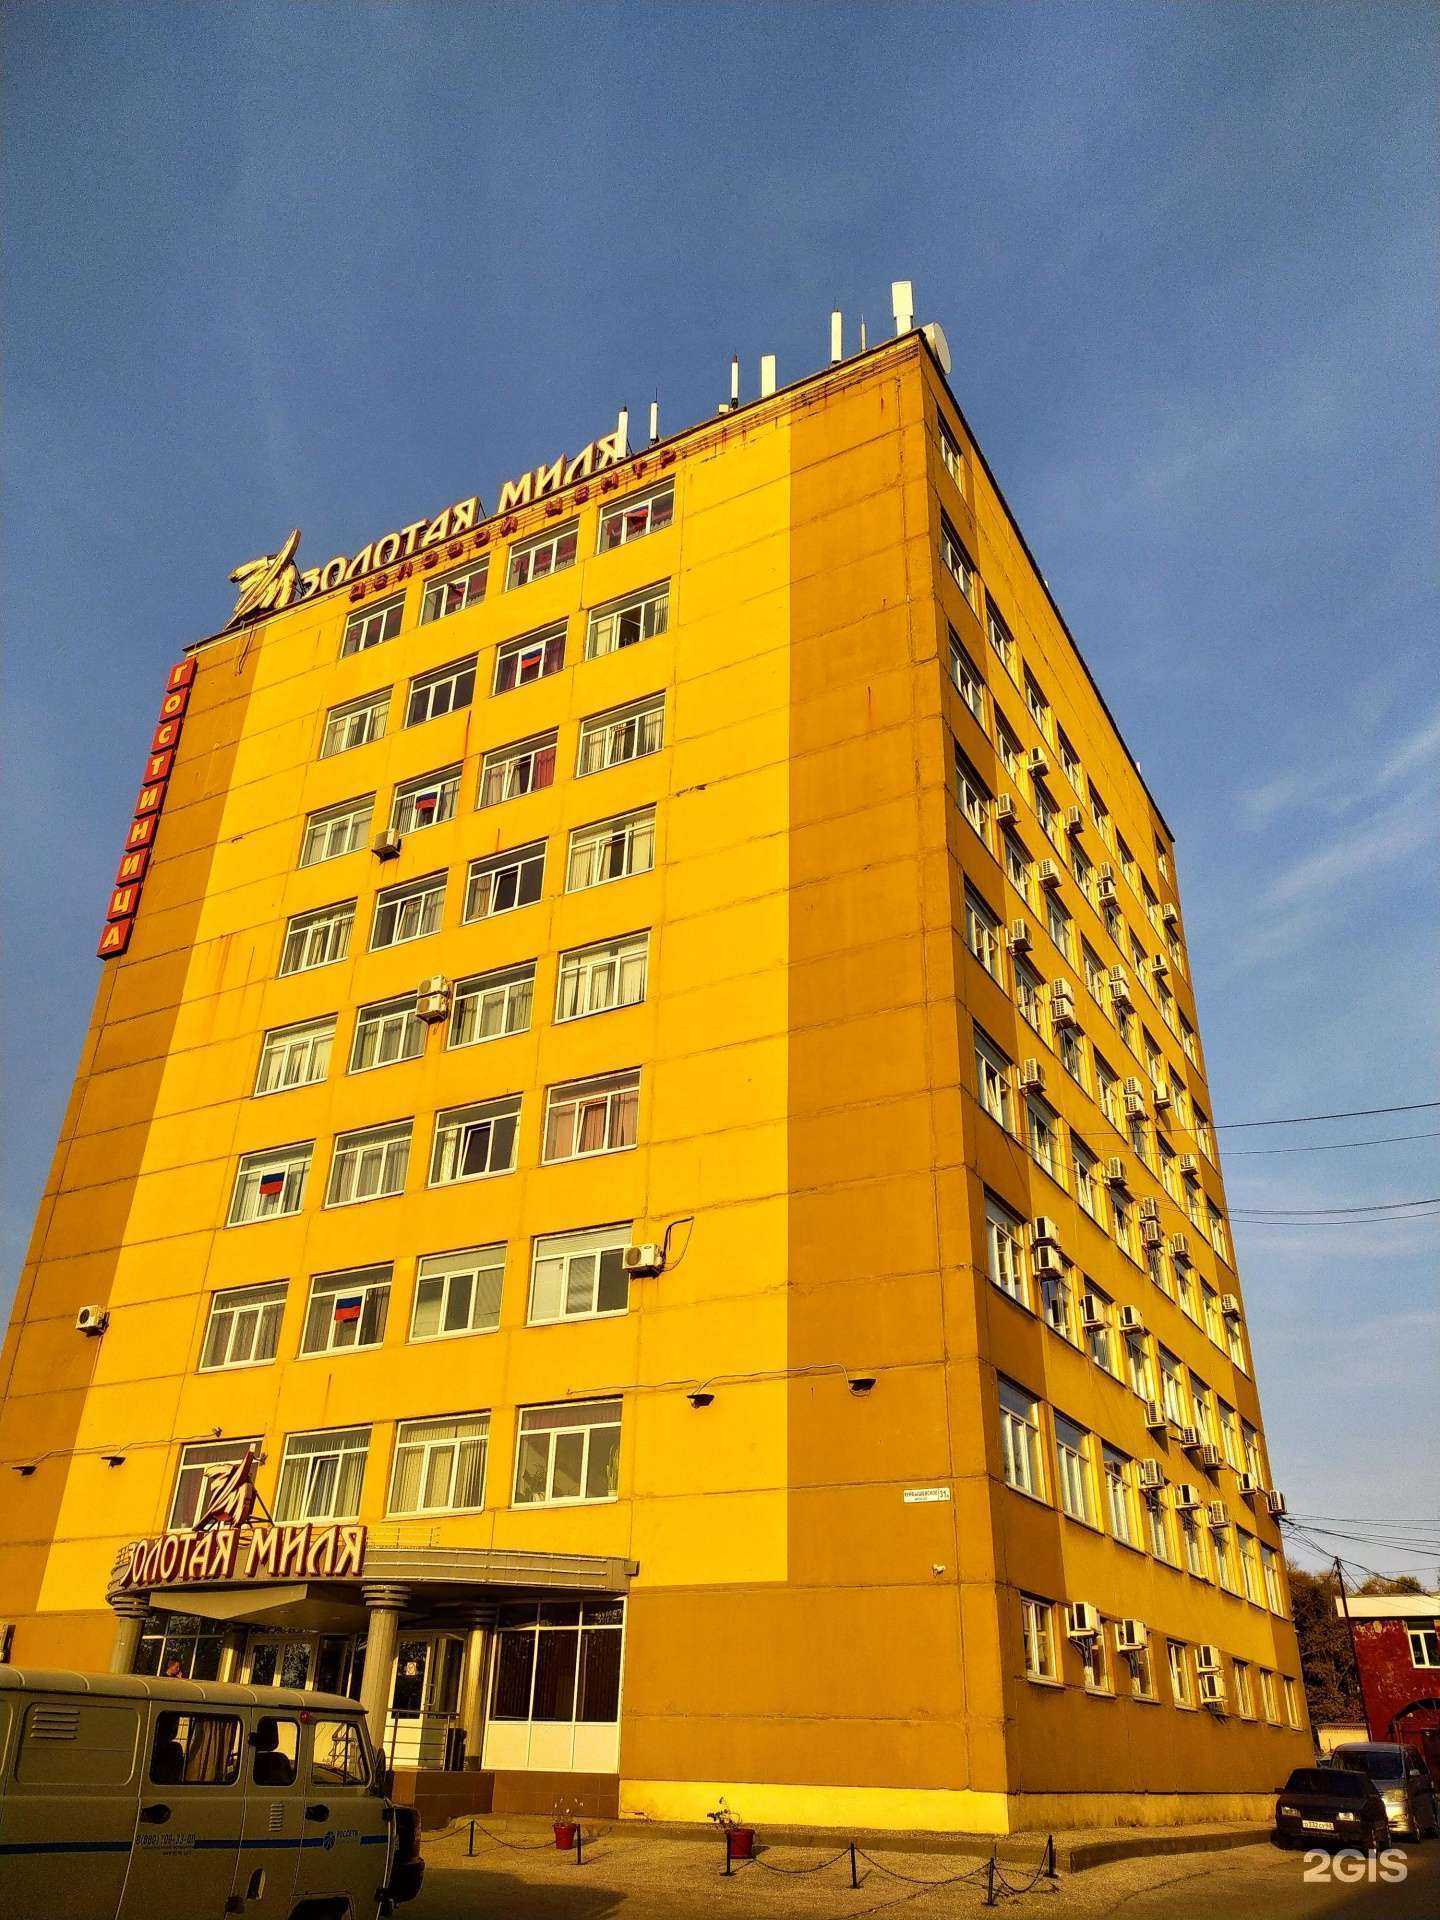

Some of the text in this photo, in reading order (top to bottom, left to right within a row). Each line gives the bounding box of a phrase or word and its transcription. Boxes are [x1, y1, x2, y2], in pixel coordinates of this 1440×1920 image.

[300, 431, 626, 599] ЗОЛОТАЯ МИЛЯ
[101, 663, 188, 949] ГОСТИНИЦА
[118, 1524, 366, 1587] ЗОЛОТАЯ МИЛЯ
